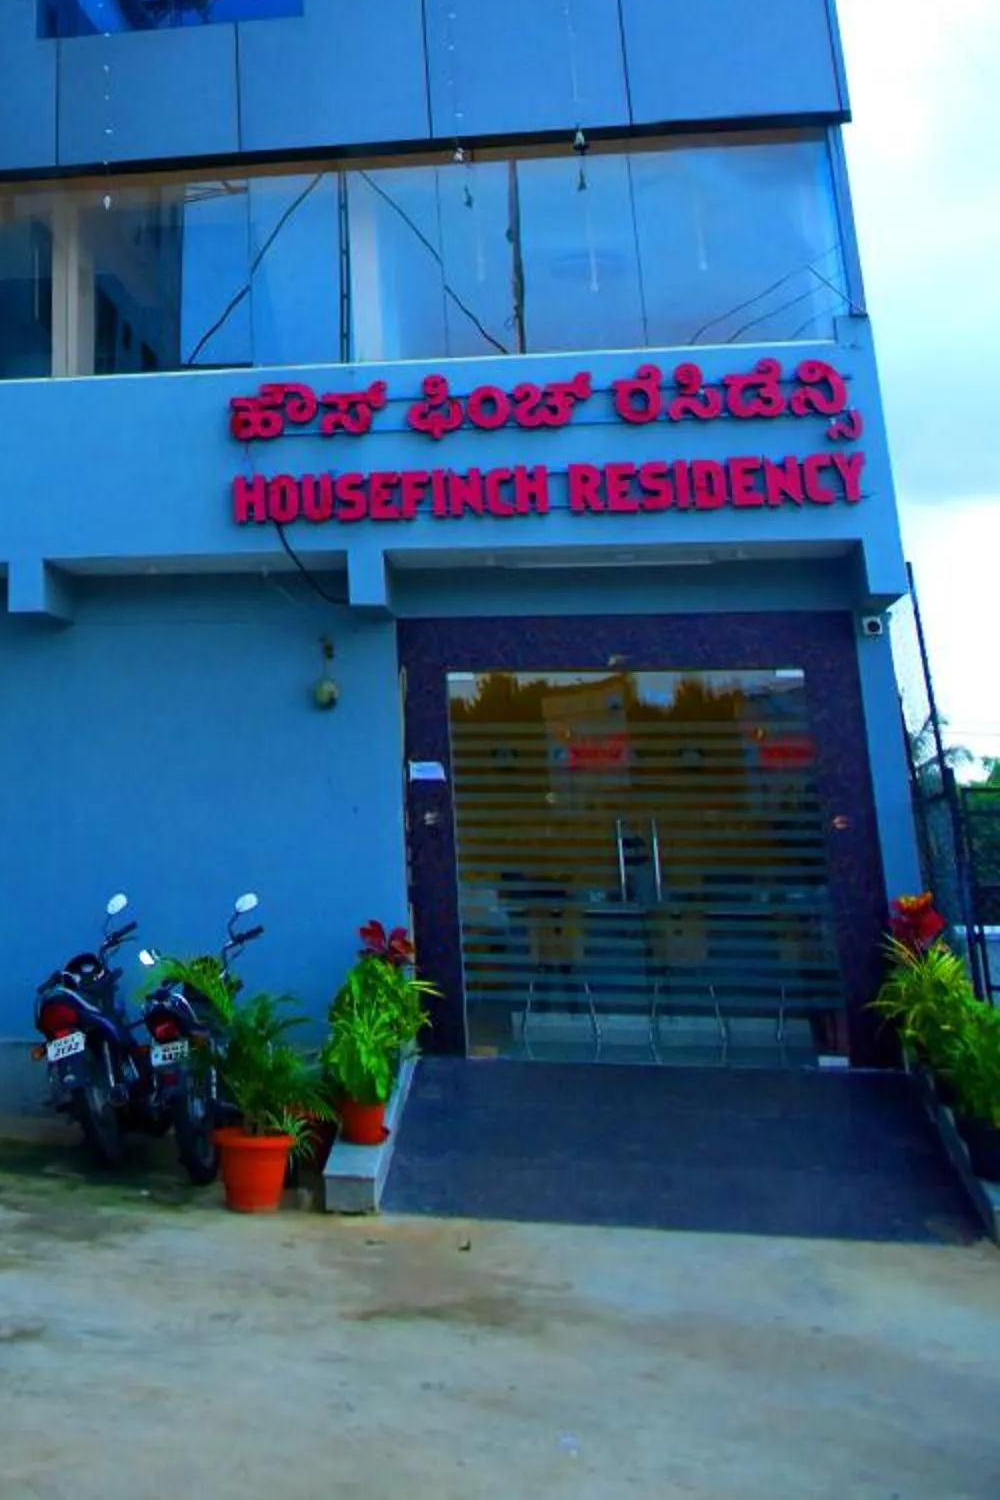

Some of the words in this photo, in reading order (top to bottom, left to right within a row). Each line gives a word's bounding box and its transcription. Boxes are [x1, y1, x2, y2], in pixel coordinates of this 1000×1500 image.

[230, 380, 388, 440] ಹೌಸ್
[407, 371, 592, 440] ಫಿಂಚ್
[612, 357, 863, 442] ರೆಸಿಡೆನ್ಸಿ
[233, 464, 549, 524] HOUSEFINCH
[567, 451, 866, 517] RESIDENCY
